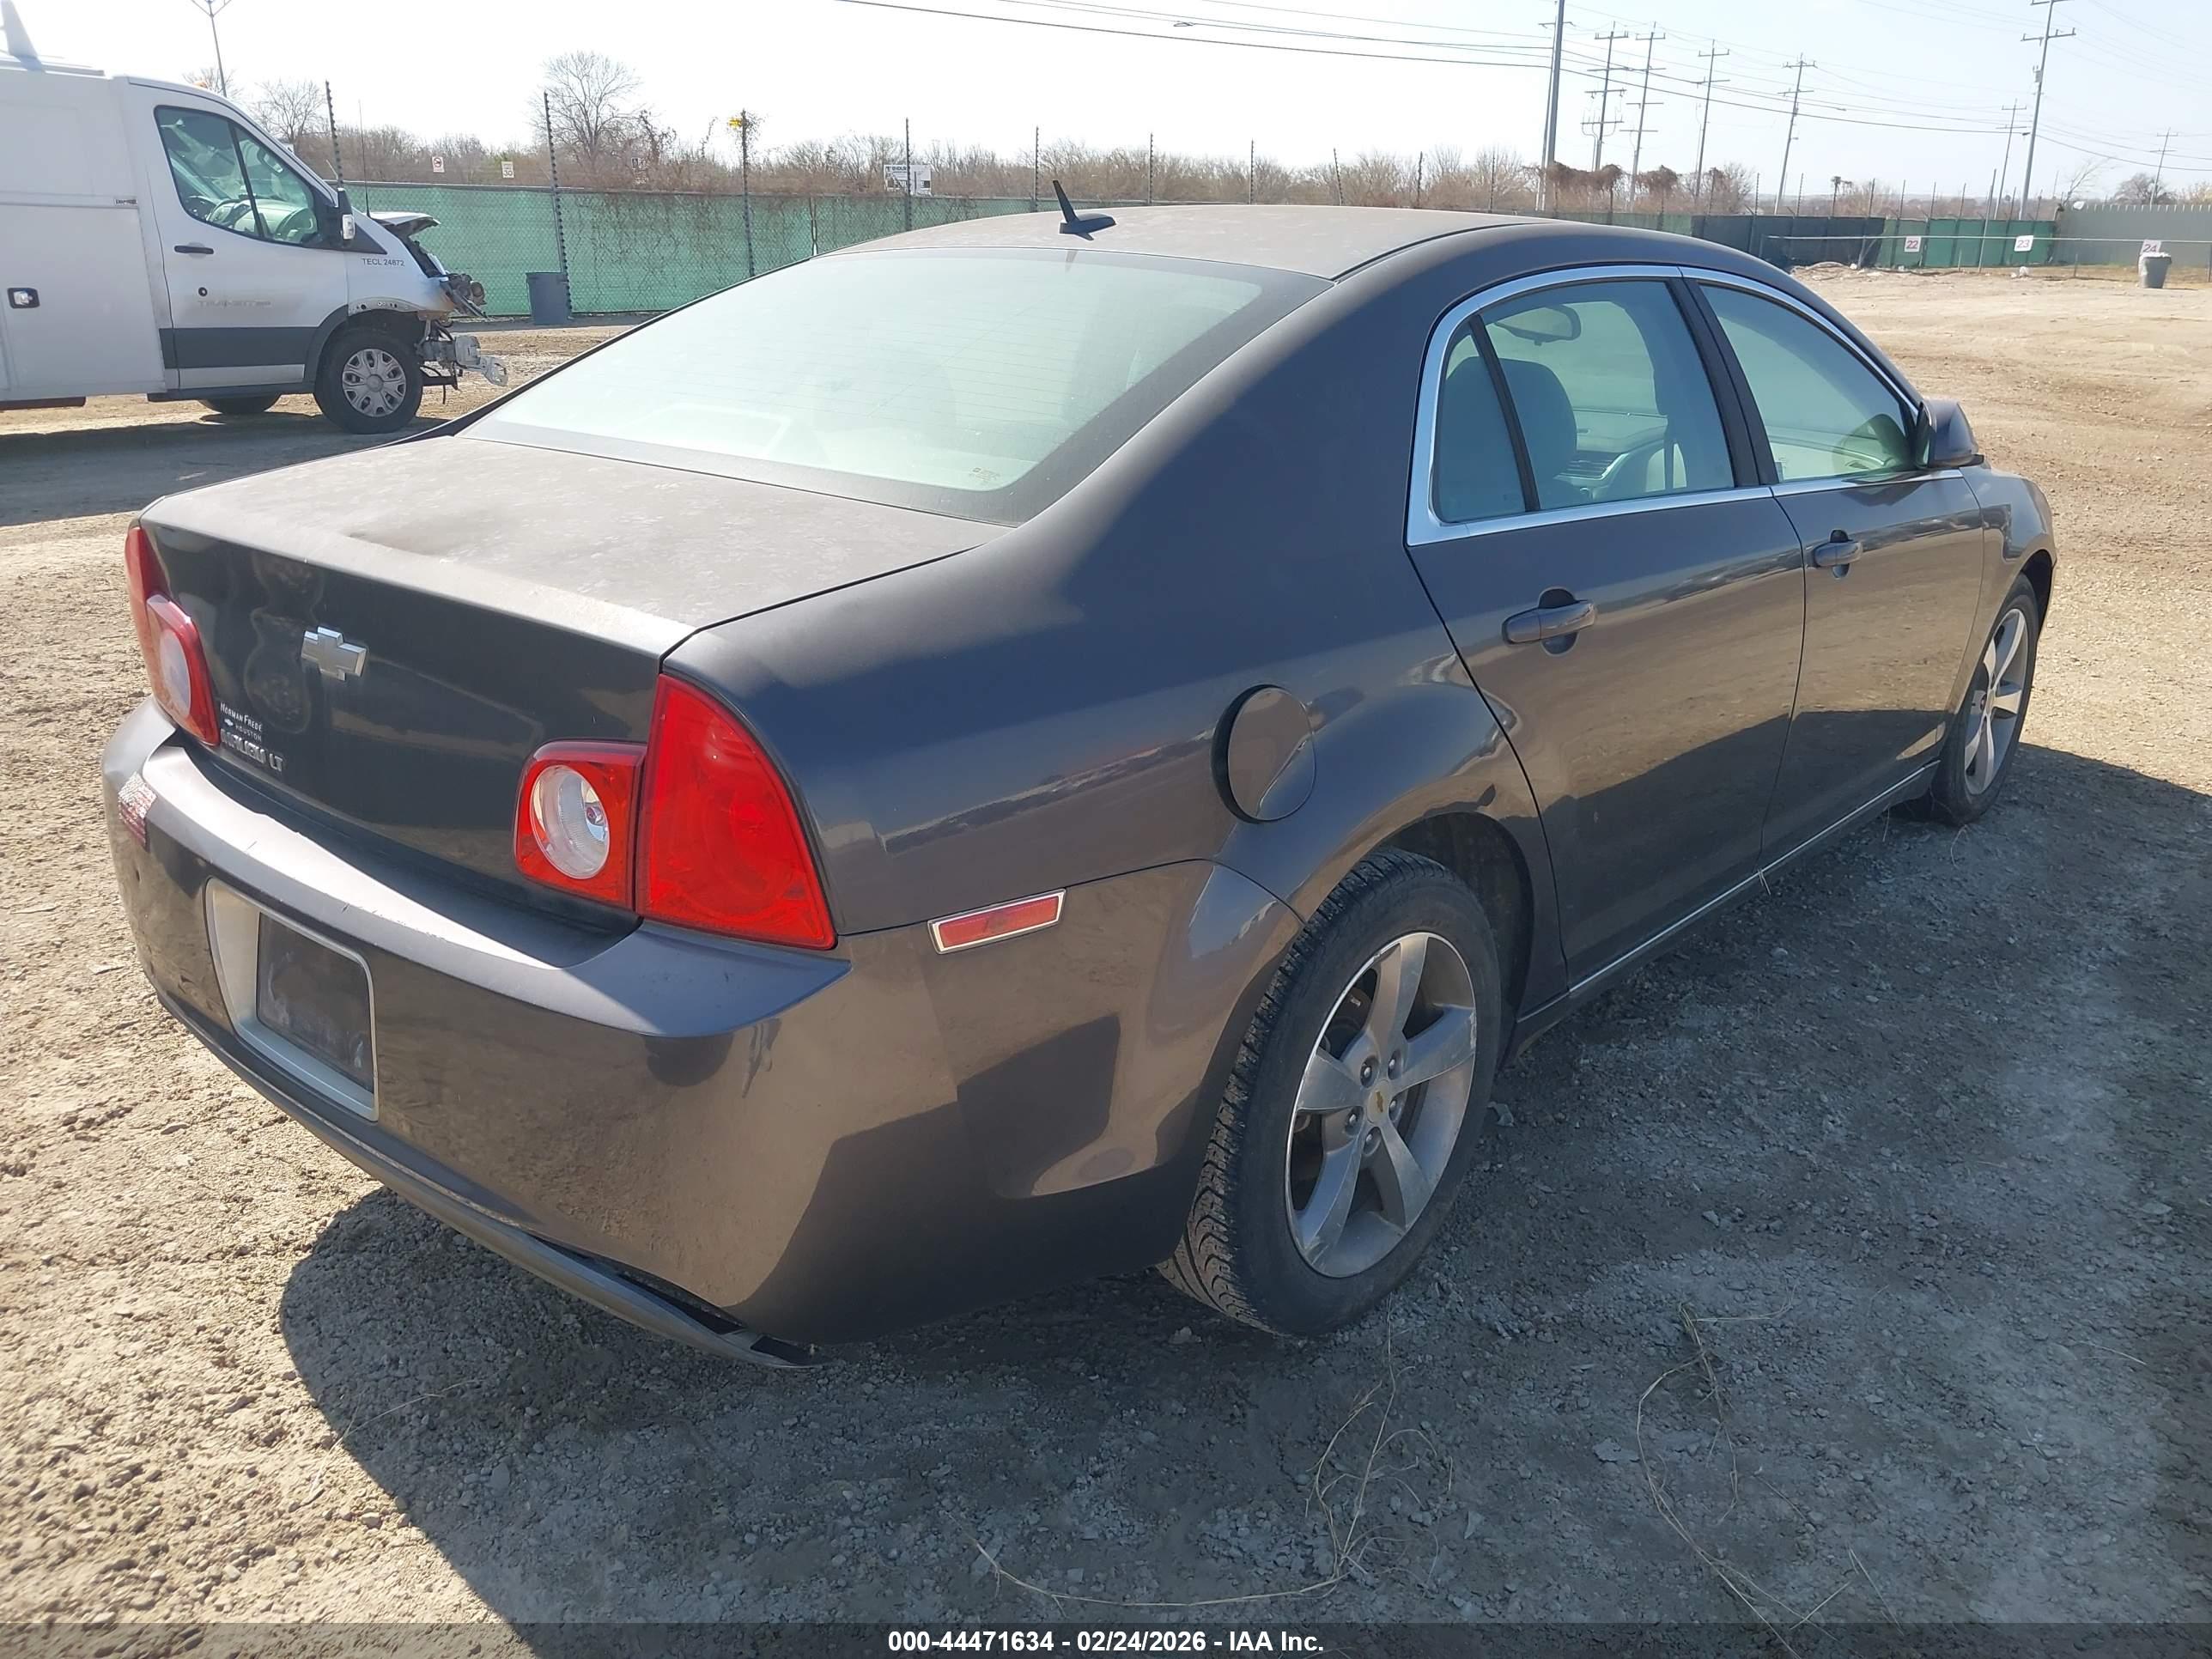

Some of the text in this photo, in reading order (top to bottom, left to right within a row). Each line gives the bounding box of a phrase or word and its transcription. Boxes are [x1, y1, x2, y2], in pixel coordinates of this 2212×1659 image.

[1906, 240, 1918, 249] 22
[2017, 240, 2030, 248] 23
[2142, 244, 2157, 252] 24
[220, 702, 262, 732] NORMAN FREDE
[235, 724, 262, 741] HOUSTON
[269, 753, 283, 772] LT
